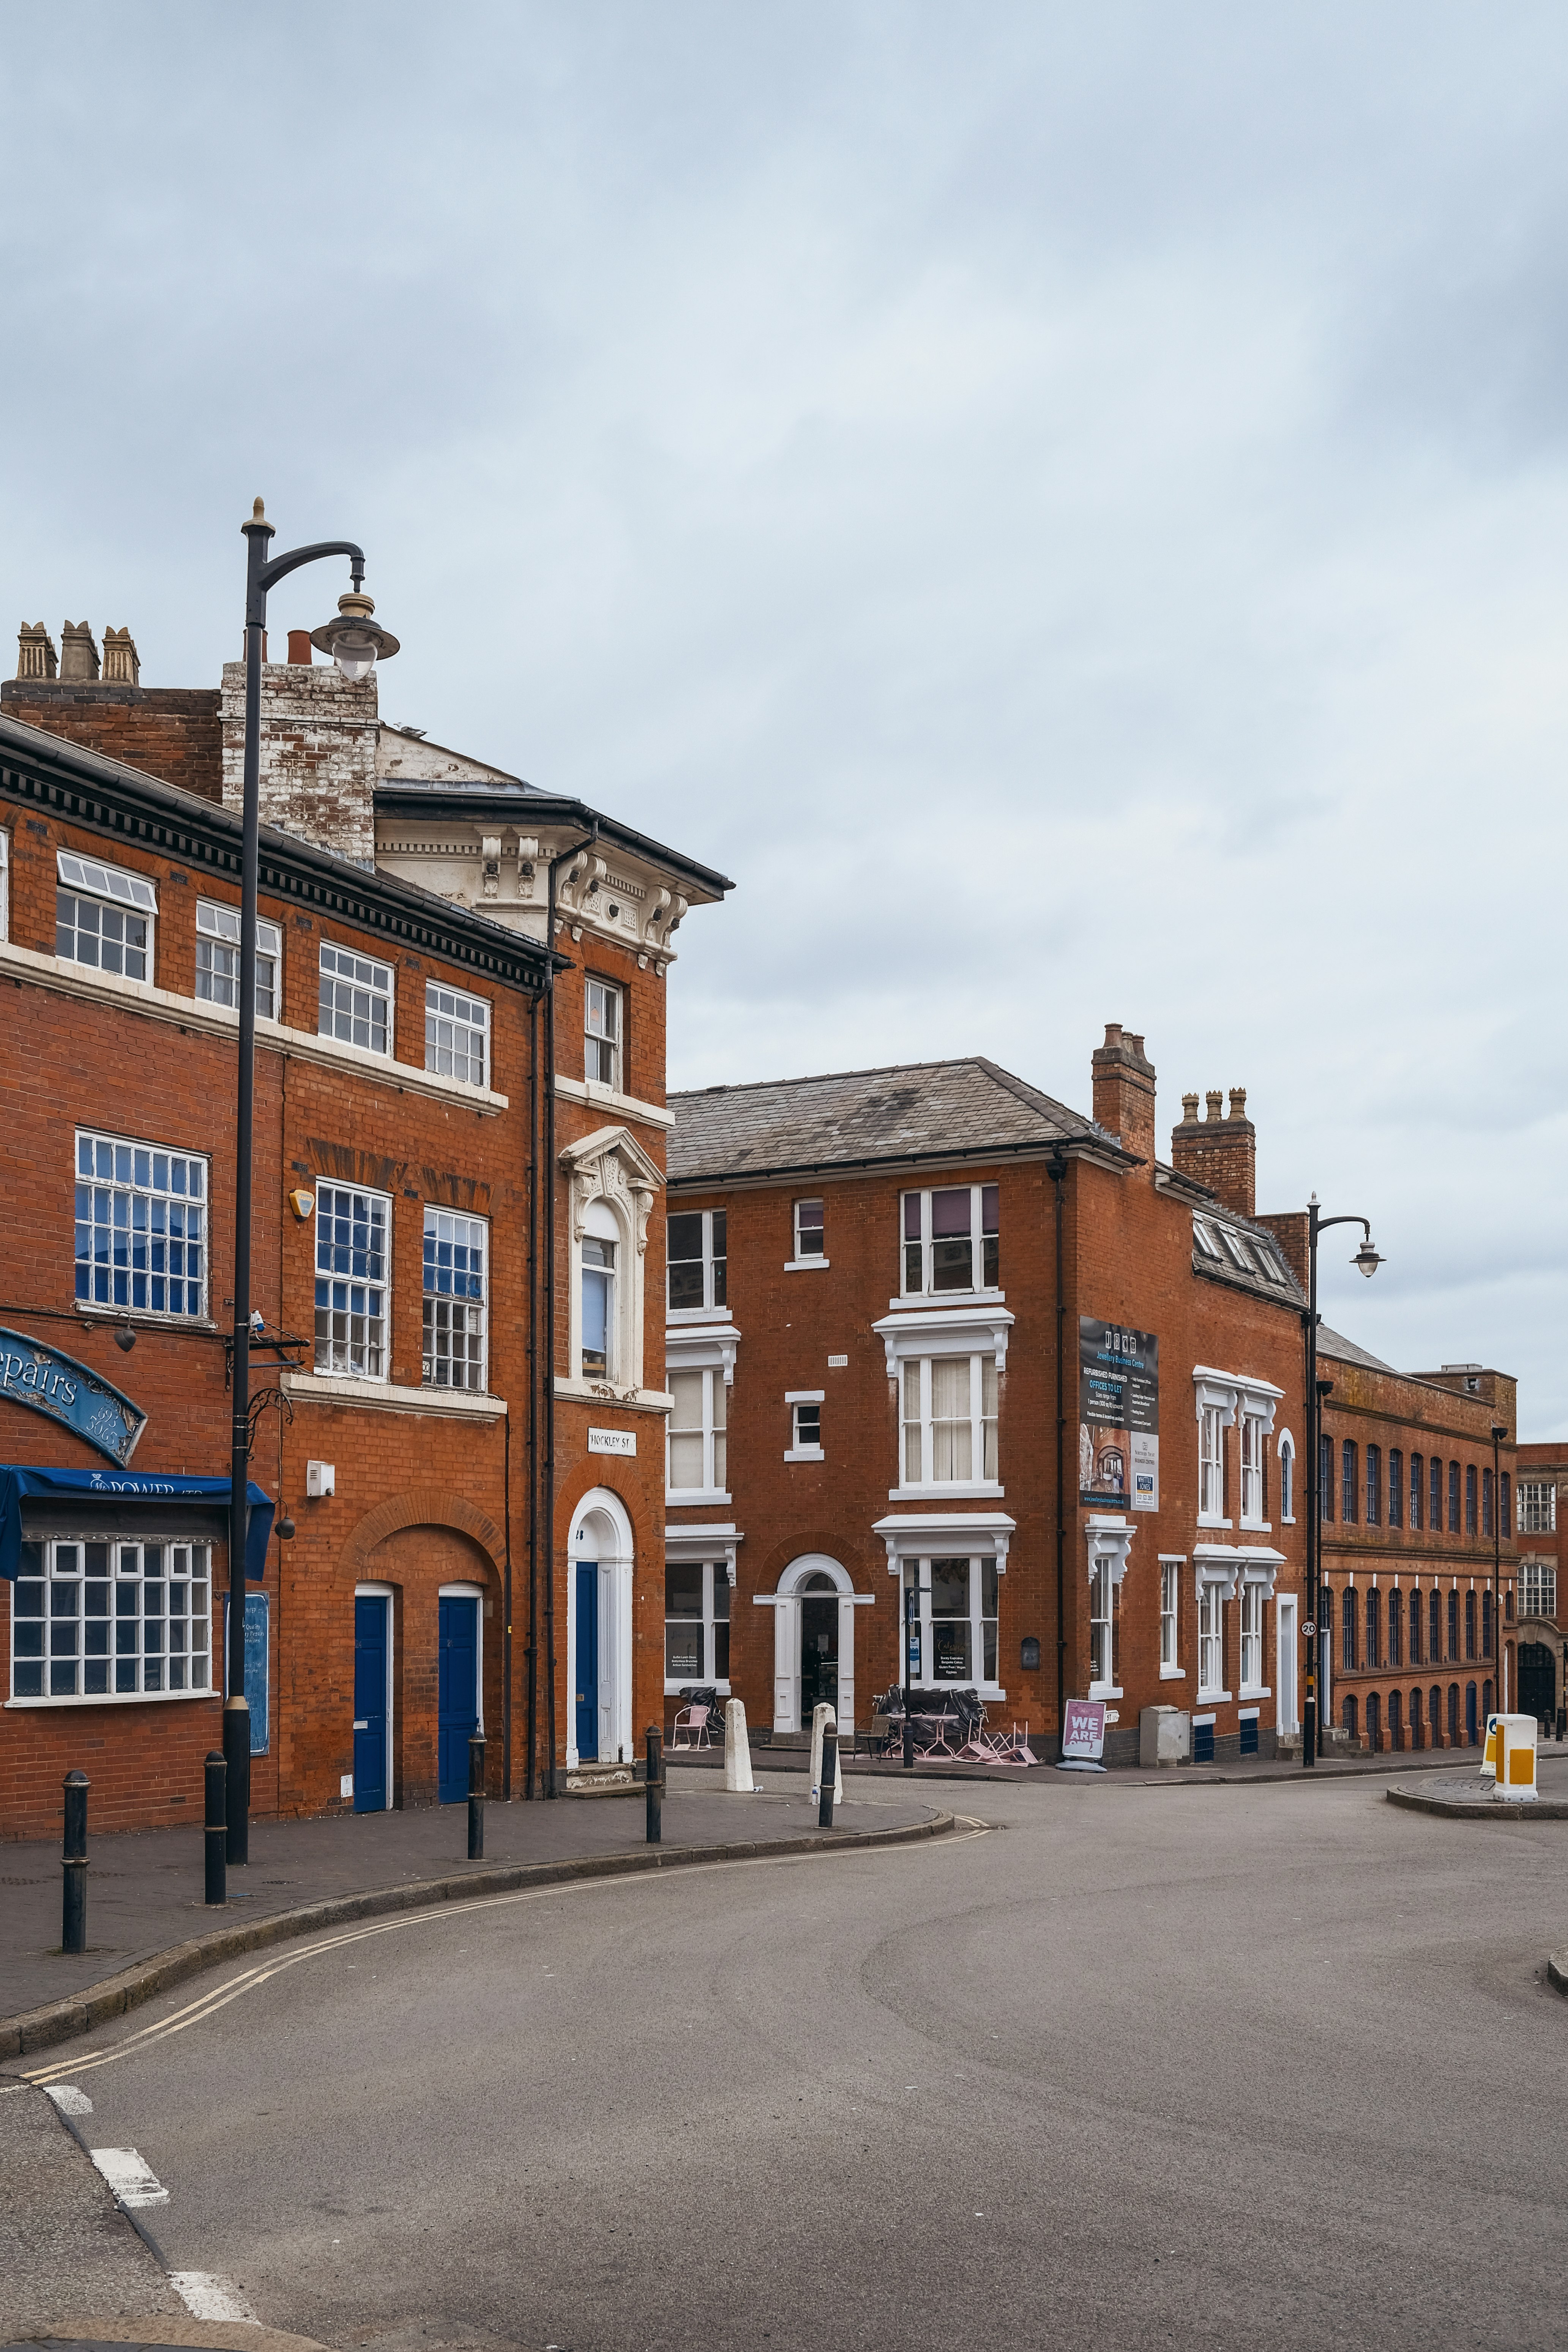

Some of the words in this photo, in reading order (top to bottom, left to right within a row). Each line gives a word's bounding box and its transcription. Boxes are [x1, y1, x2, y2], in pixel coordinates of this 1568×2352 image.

[1097, 1351, 1115, 1363] Jewellery
[1115, 1355, 1131, 1366] Business
[1132, 1359, 1144, 1369] Centre
[1084, 1367, 1108, 1378] REFURBISHED
[1108, 1372, 1128, 1382] FURNISHED
[1089, 1380, 1107, 1391] OFFICES
[1108, 1383, 1114, 1392] TO
[592, 1434, 620, 1447] HOCKLEY
[622, 1438, 629, 1448] ST
[1072, 1716, 1099, 1730] WE
[1070, 1730, 1098, 1742] ARE
